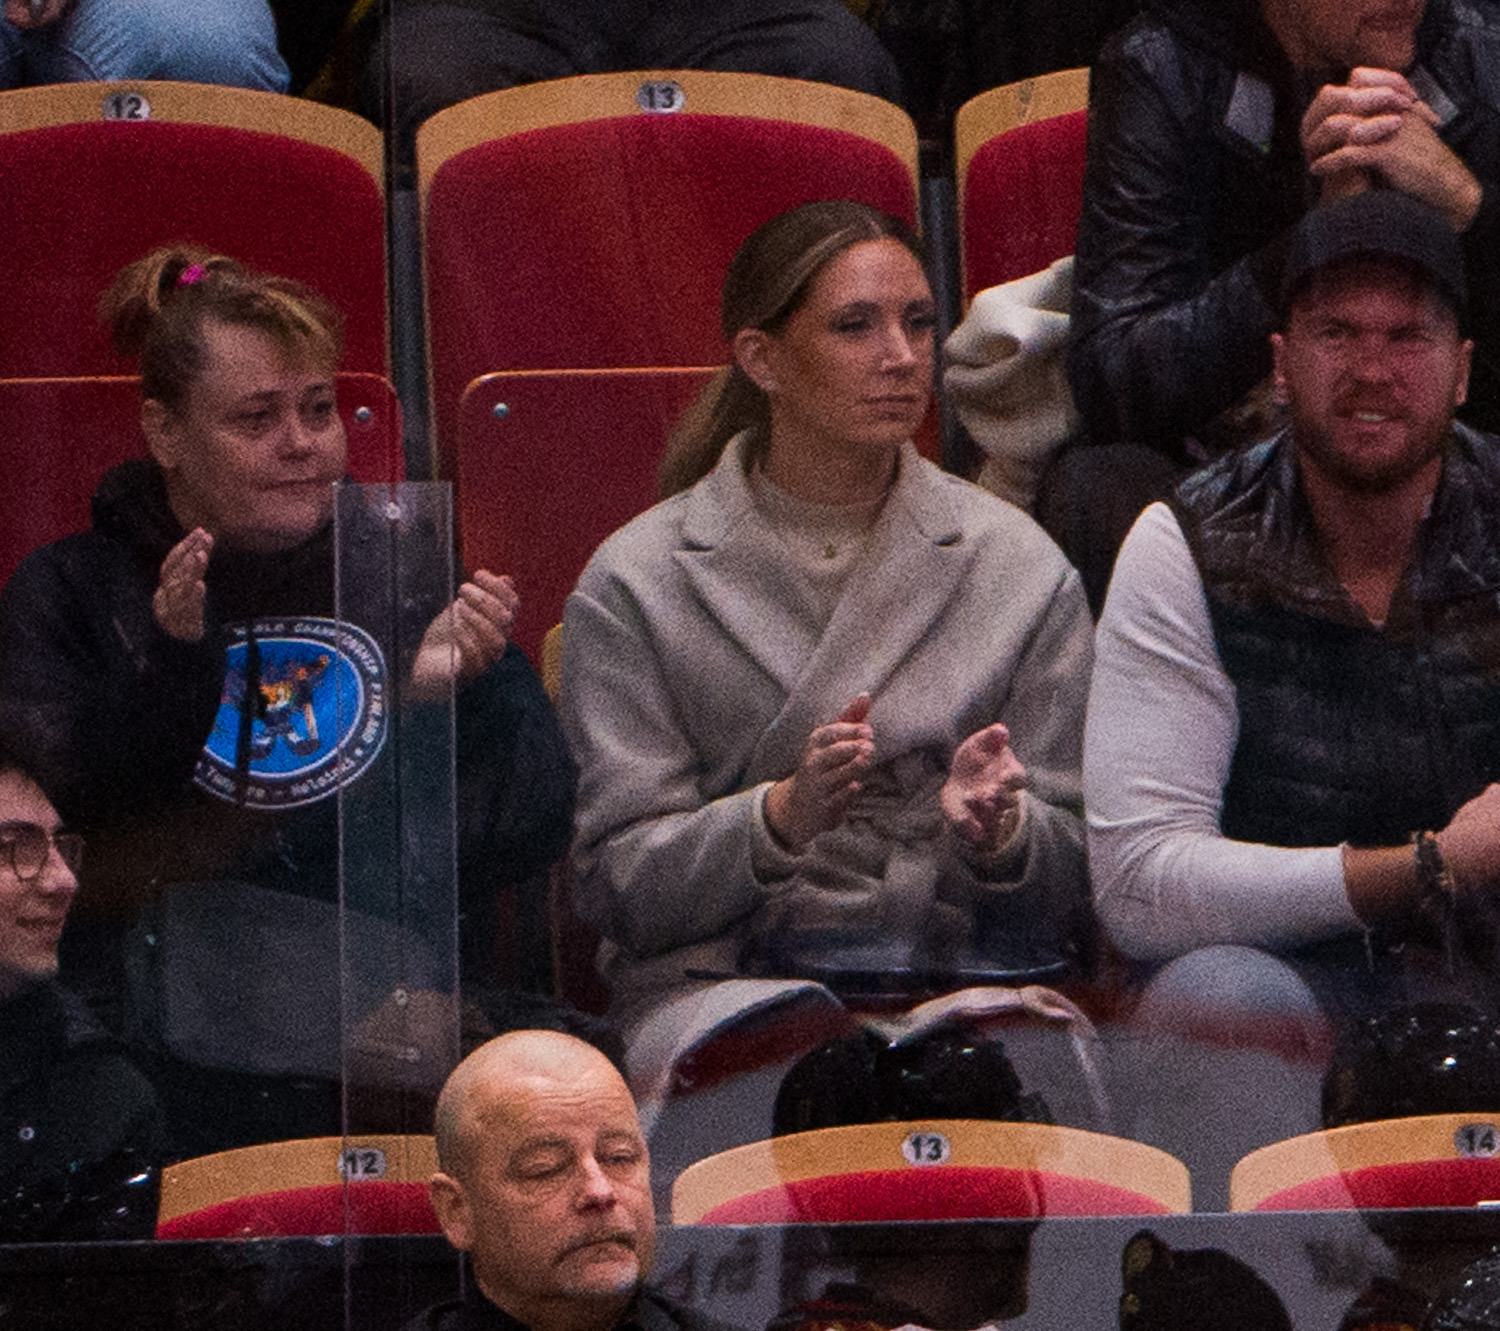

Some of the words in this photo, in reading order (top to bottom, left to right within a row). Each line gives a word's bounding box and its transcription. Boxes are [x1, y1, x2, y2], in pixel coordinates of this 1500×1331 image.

[112, 96, 142, 119] 12
[647, 85, 675, 108] 13
[910, 1133, 942, 1160] 13
[1466, 1128, 1496, 1153] 14
[345, 1151, 379, 1175] 12
